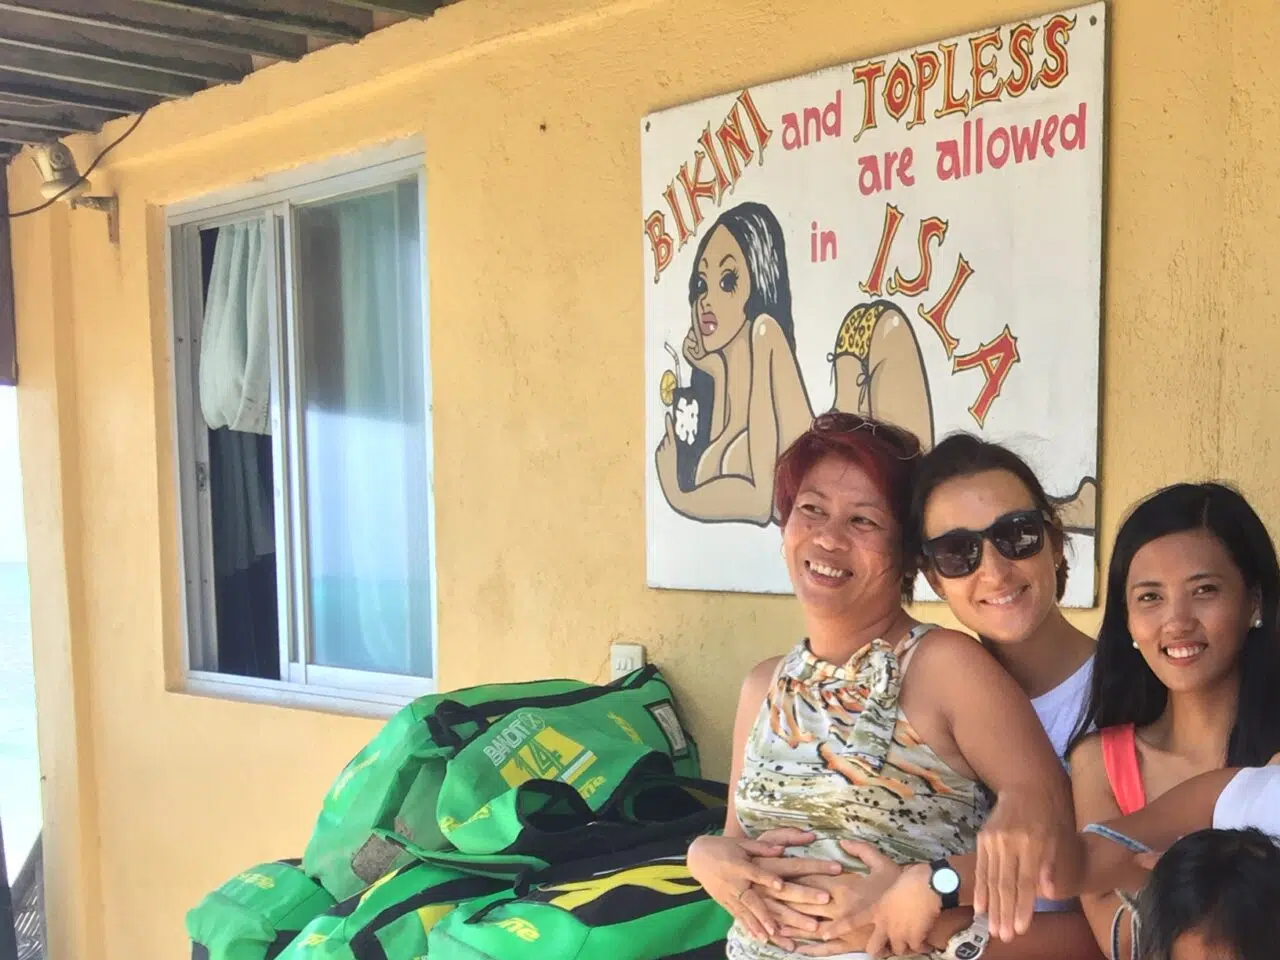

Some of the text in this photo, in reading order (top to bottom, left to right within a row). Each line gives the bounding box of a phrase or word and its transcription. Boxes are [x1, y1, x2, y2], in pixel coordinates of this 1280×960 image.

[644, 14, 1078, 283] BIKINI and TOPLESS
[858, 103, 1087, 197] are allowed
[810, 202, 1019, 430] in ISLA
[483, 716, 531, 767] BANDIT
